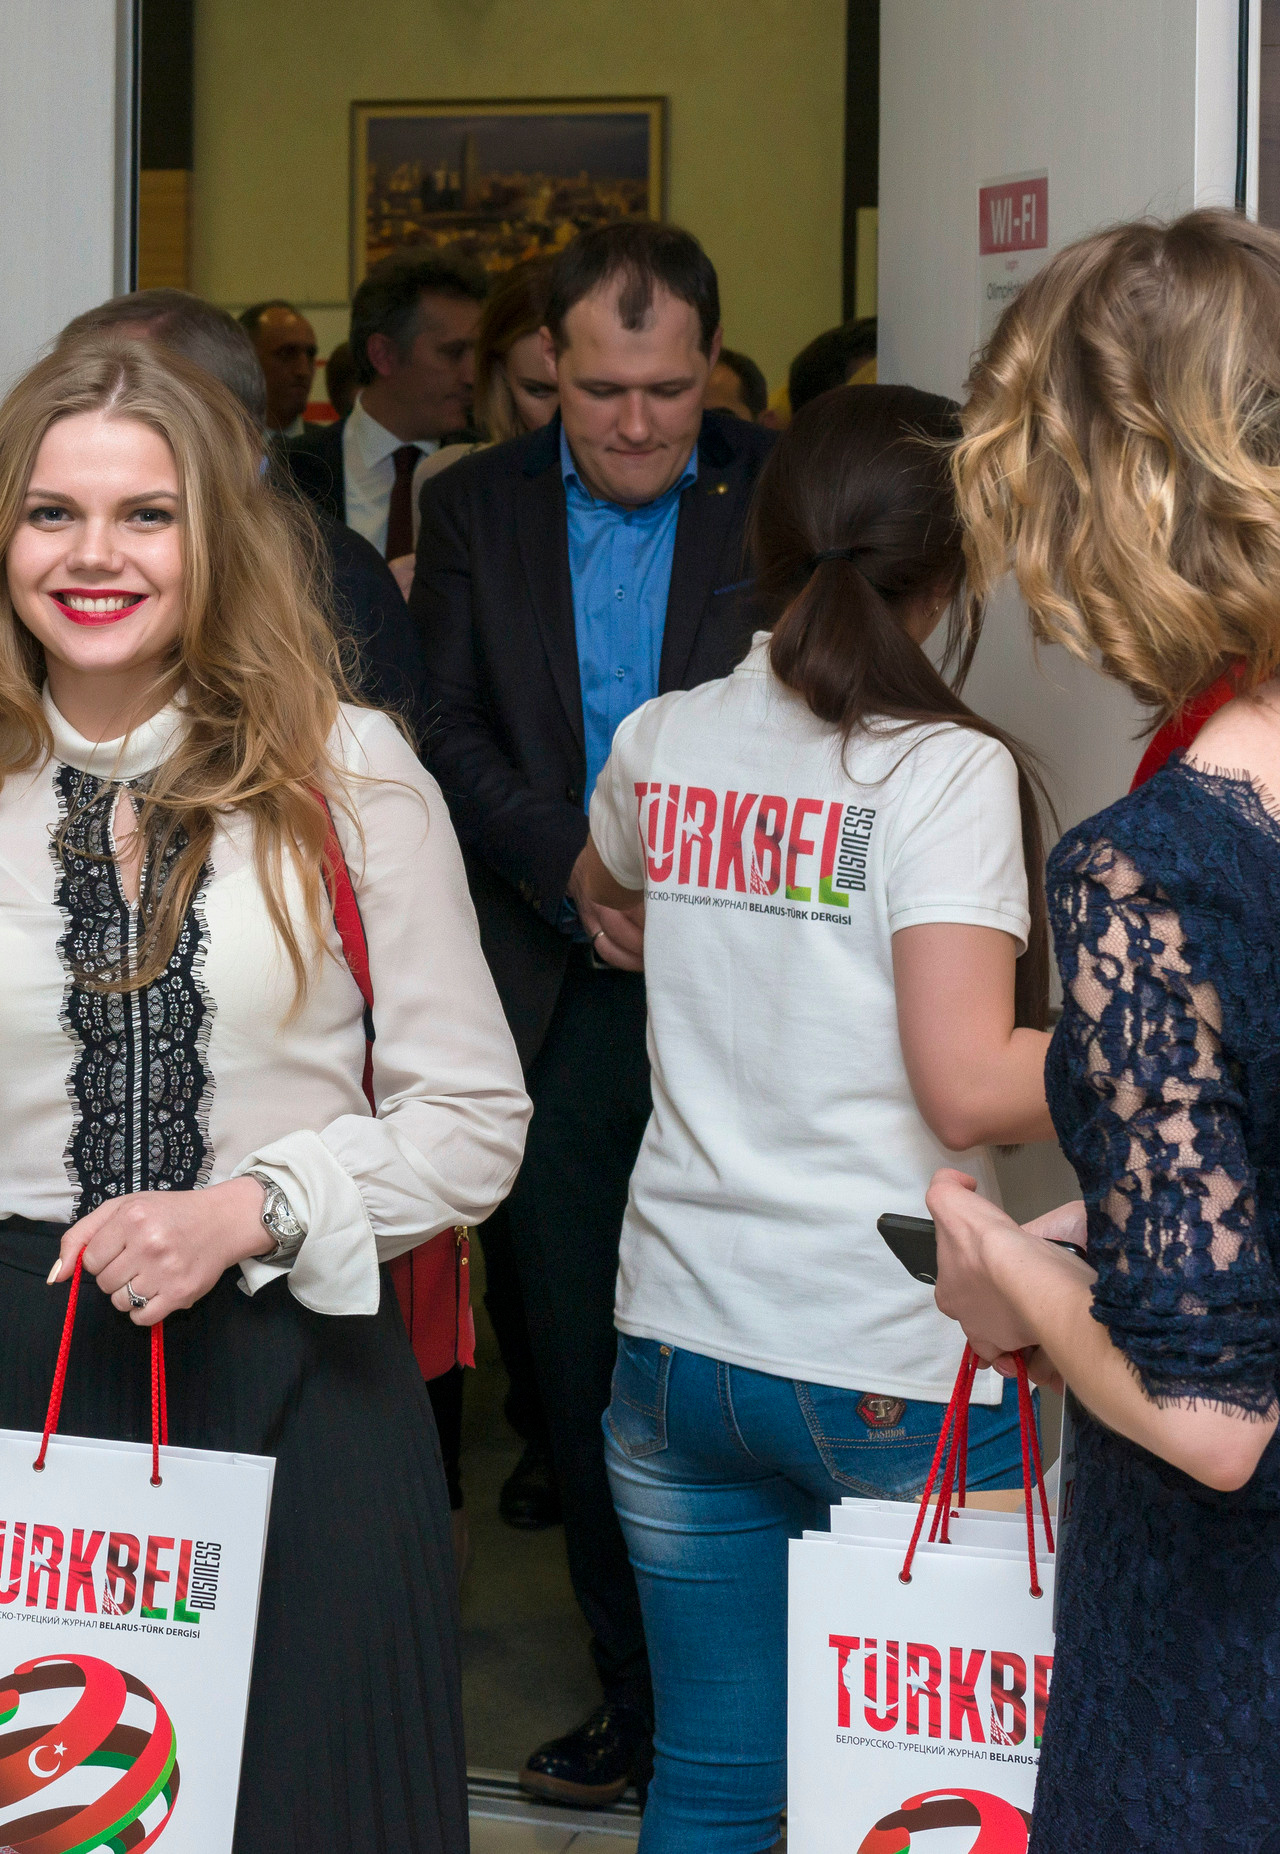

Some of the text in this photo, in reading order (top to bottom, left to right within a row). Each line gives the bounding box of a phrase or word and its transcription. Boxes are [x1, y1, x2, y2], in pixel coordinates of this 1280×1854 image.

[990, 193, 1036, 245] WI-FI
[836, 805, 876, 891] BUSINESS
[712, 898, 748, 911] ЖУРНАЛ
[749, 903, 808, 920] BELARUS-TÜRK
[190, 1541, 222, 1610] BUSINESS
[61, 1618, 97, 1629] ЖУРНАЛ
[99, 1621, 164, 1635] BELARUS-TÜRK
[836, 1734, 946, 1756] БЕЛОРУССКО-ТУРЕЦКИЙ
[947, 1747, 988, 1760] ЖУРНАЛ
